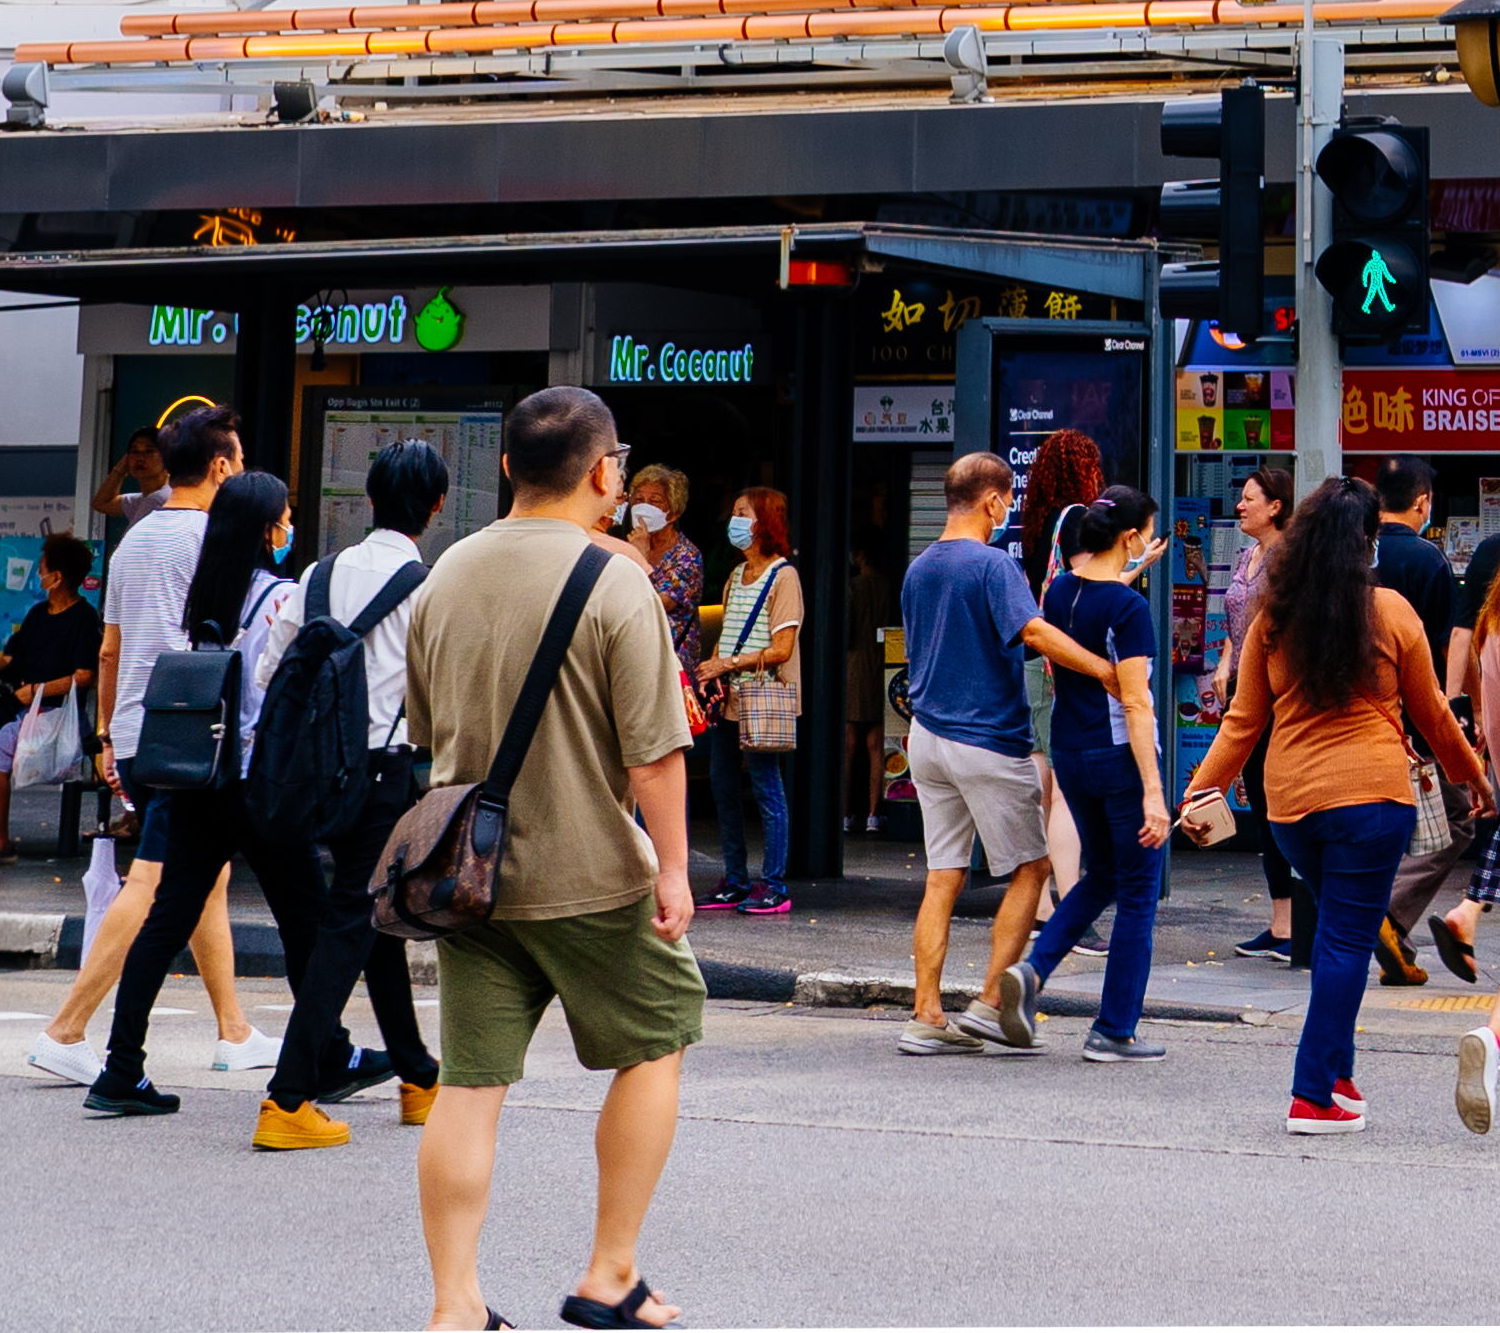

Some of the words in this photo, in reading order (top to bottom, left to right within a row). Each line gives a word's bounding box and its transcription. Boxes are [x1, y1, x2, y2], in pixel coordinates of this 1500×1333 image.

[149, 304, 227, 346] Mr.
[234, 295, 407, 345] conut
[1111, 338, 1124, 350] Clear
[1125, 338, 1145, 351] Channel
[610, 334, 656, 383] Mr.
[659, 340, 755, 385] Coconut
[871, 346, 908, 364] JOO
[327, 397, 345, 408] Opp
[385, 397, 400, 407] Exit
[1422, 388, 1467, 407] KING
[1018, 410, 1032, 420] Clear
[1032, 408, 1054, 420] Channel
[919, 416, 951, 434] 水果
